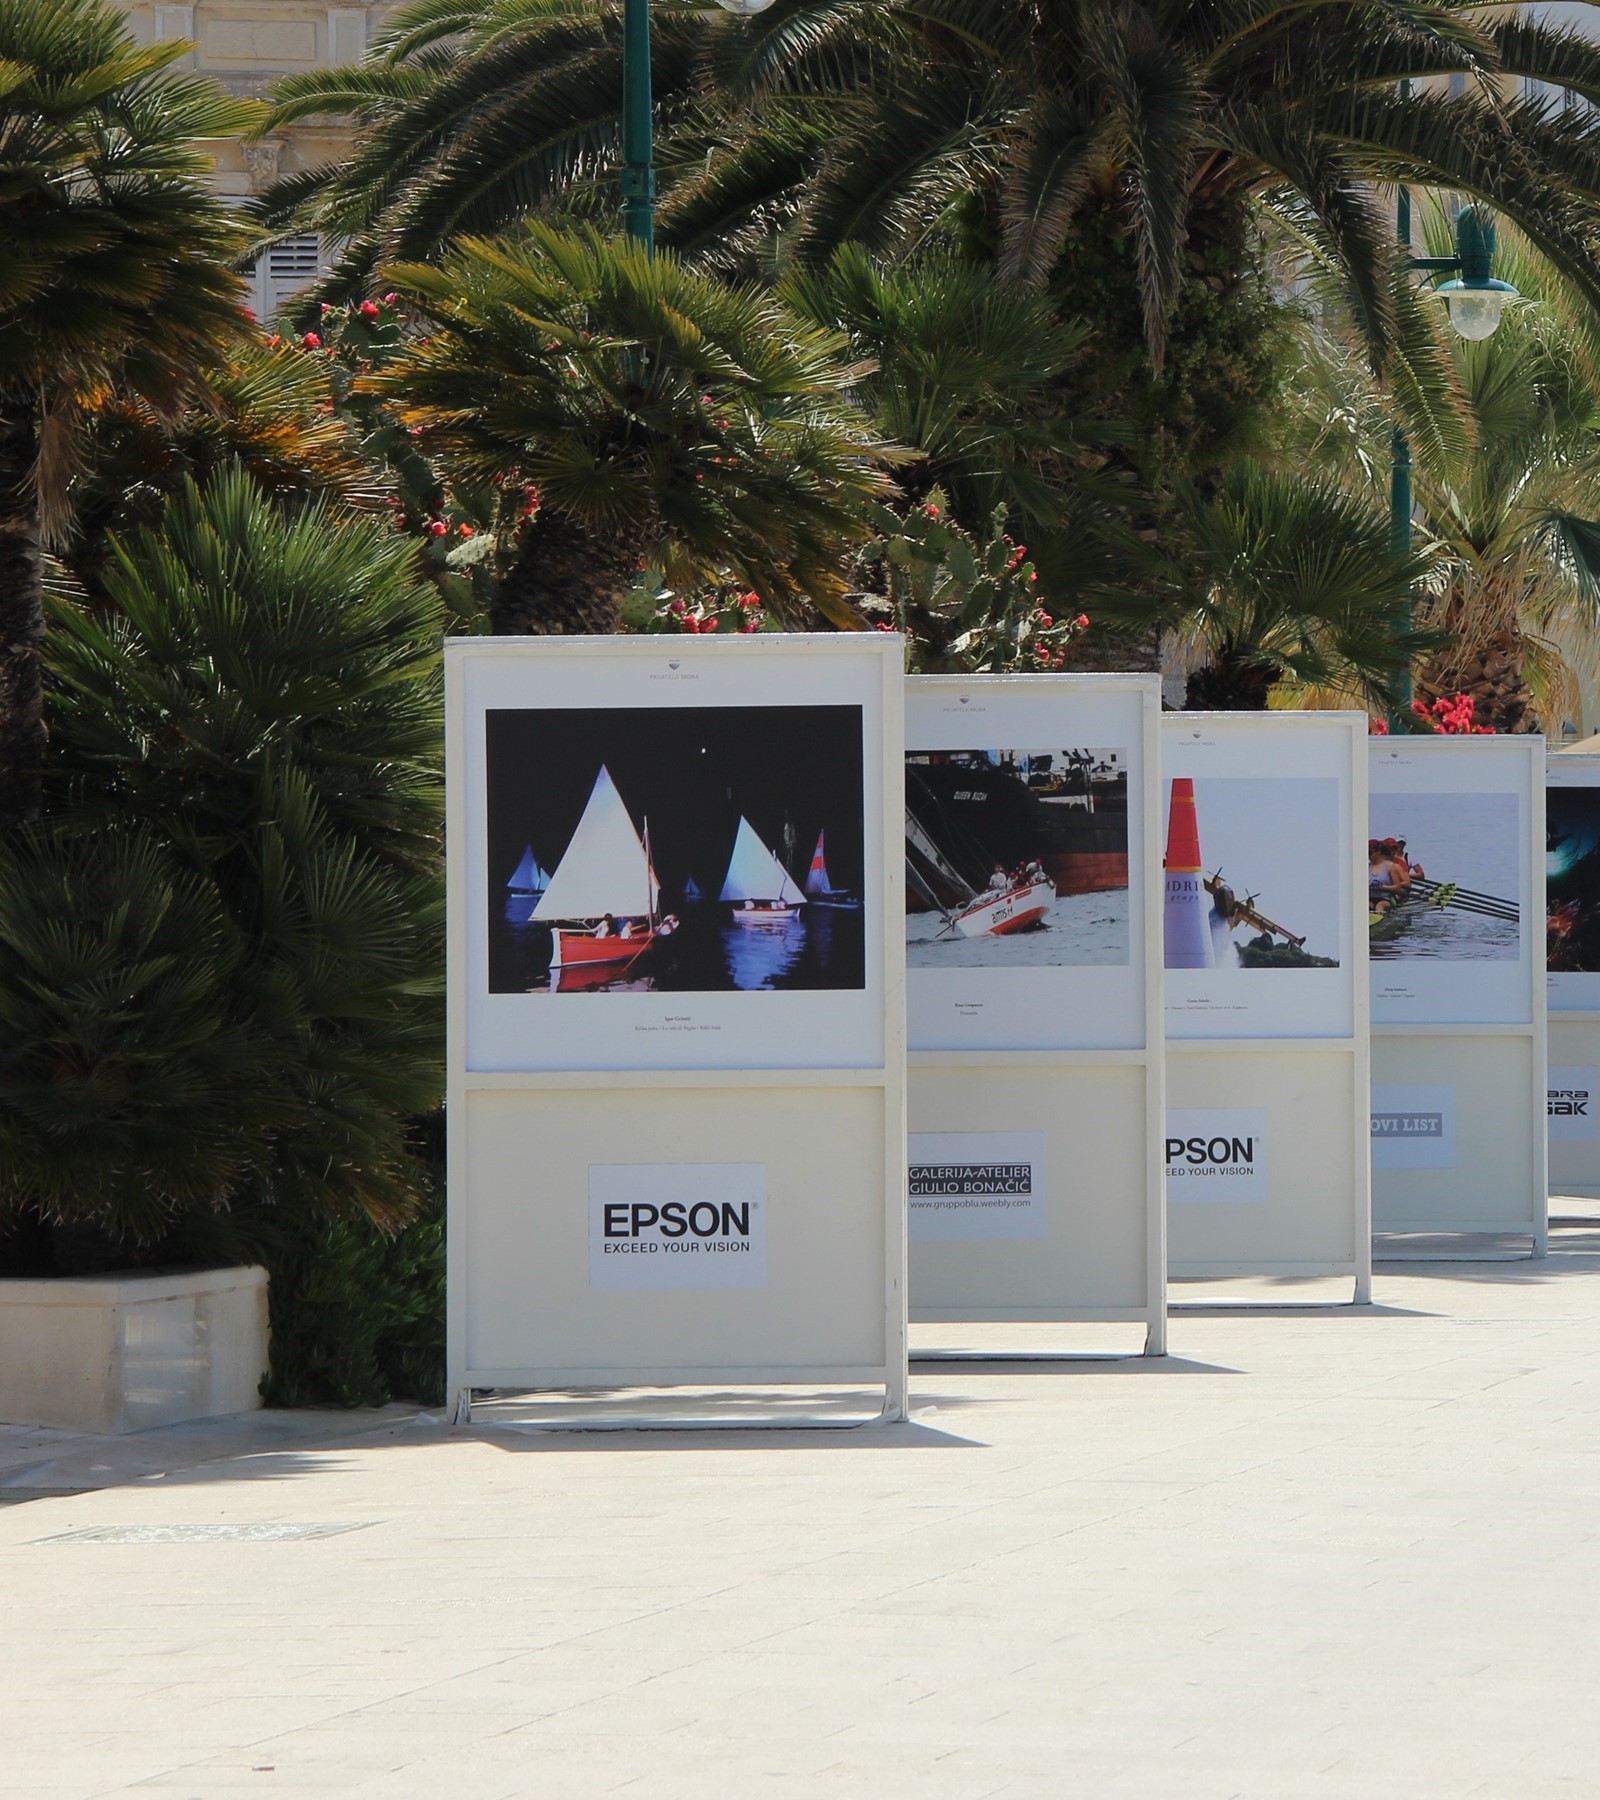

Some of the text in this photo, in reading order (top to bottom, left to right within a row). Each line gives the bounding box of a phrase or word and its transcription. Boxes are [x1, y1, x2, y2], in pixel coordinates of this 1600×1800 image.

[1370, 1119, 1438, 1132] OVI LIST
[1165, 1137, 1253, 1164] PSON
[909, 1167, 1030, 1179] GALERIJA-ATELIER
[1165, 1167, 1253, 1176] EED YOUR VISION
[909, 1178, 1030, 1194] GIULIO BONAČIĆ
[910, 1199, 1031, 1209] www.gruppoblu.weebly.com
[604, 1241, 750, 1254] EXCEED YOUR VISION
